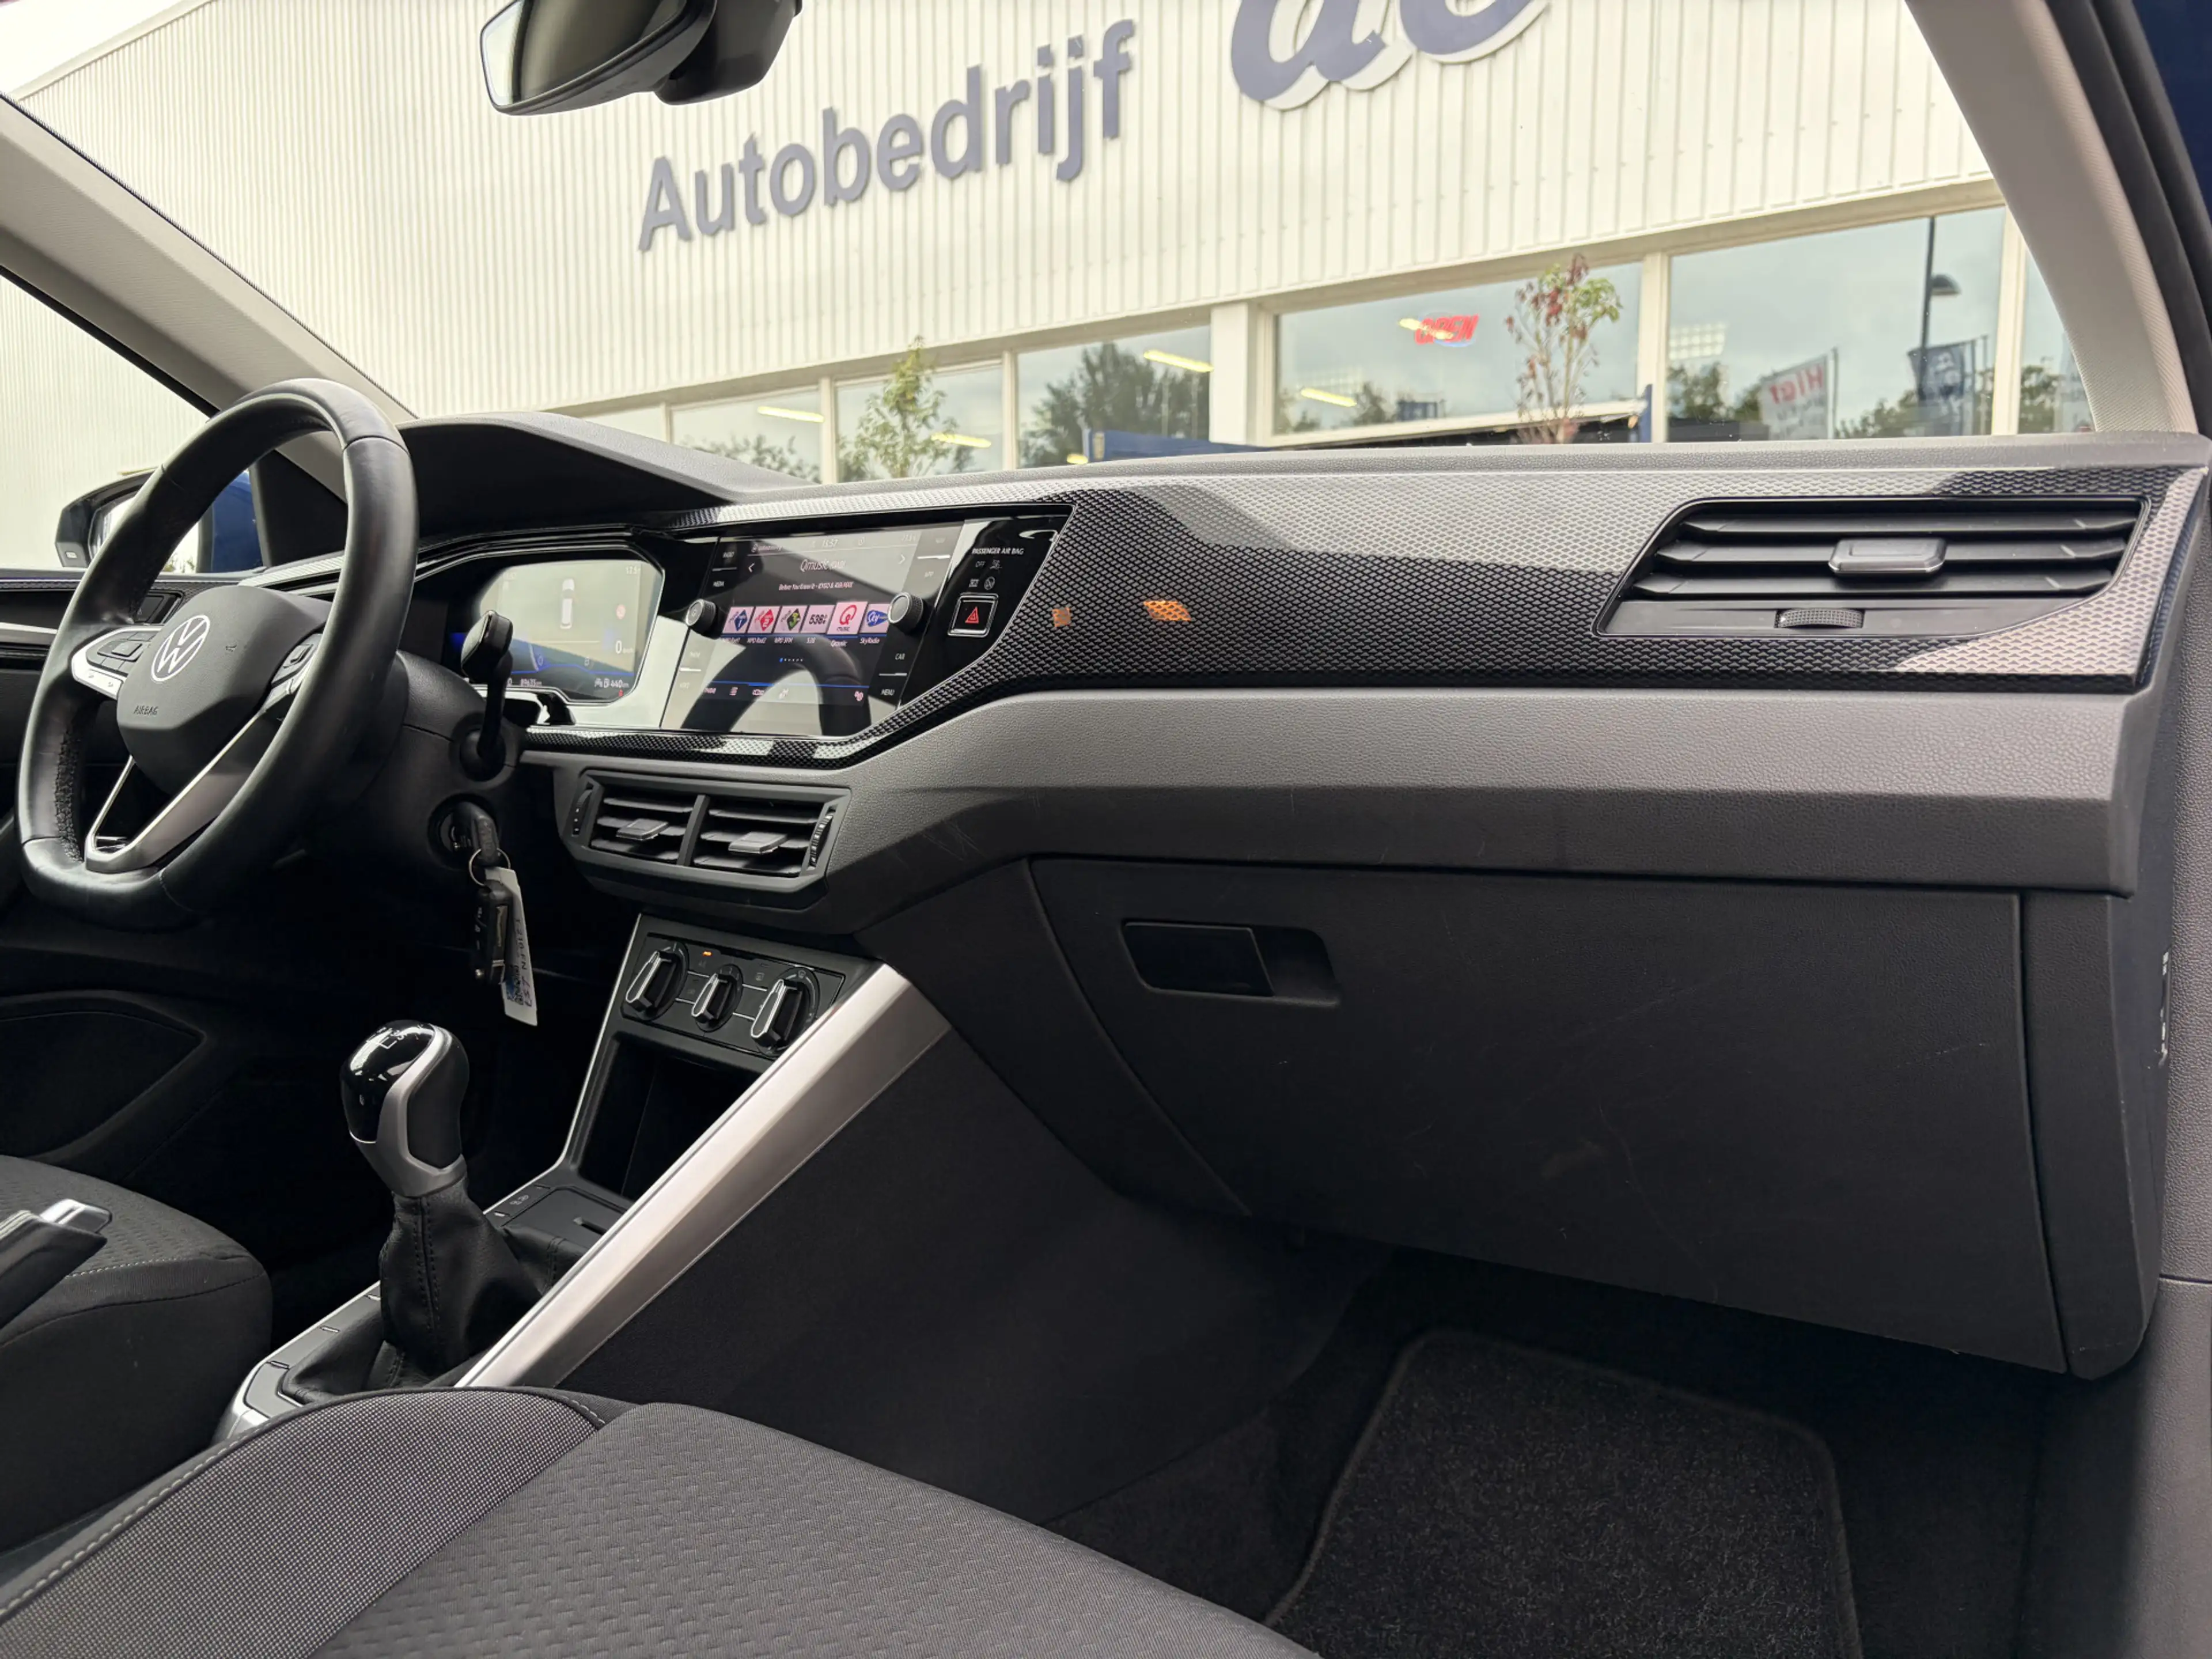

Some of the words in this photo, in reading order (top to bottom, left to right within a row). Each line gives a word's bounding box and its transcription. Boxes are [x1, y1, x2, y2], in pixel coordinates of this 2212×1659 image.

[638, 18, 1135, 252] Autobedrijf
[616, 640, 623, 654] 0
[133, 705, 159, 715] AIRBAG
